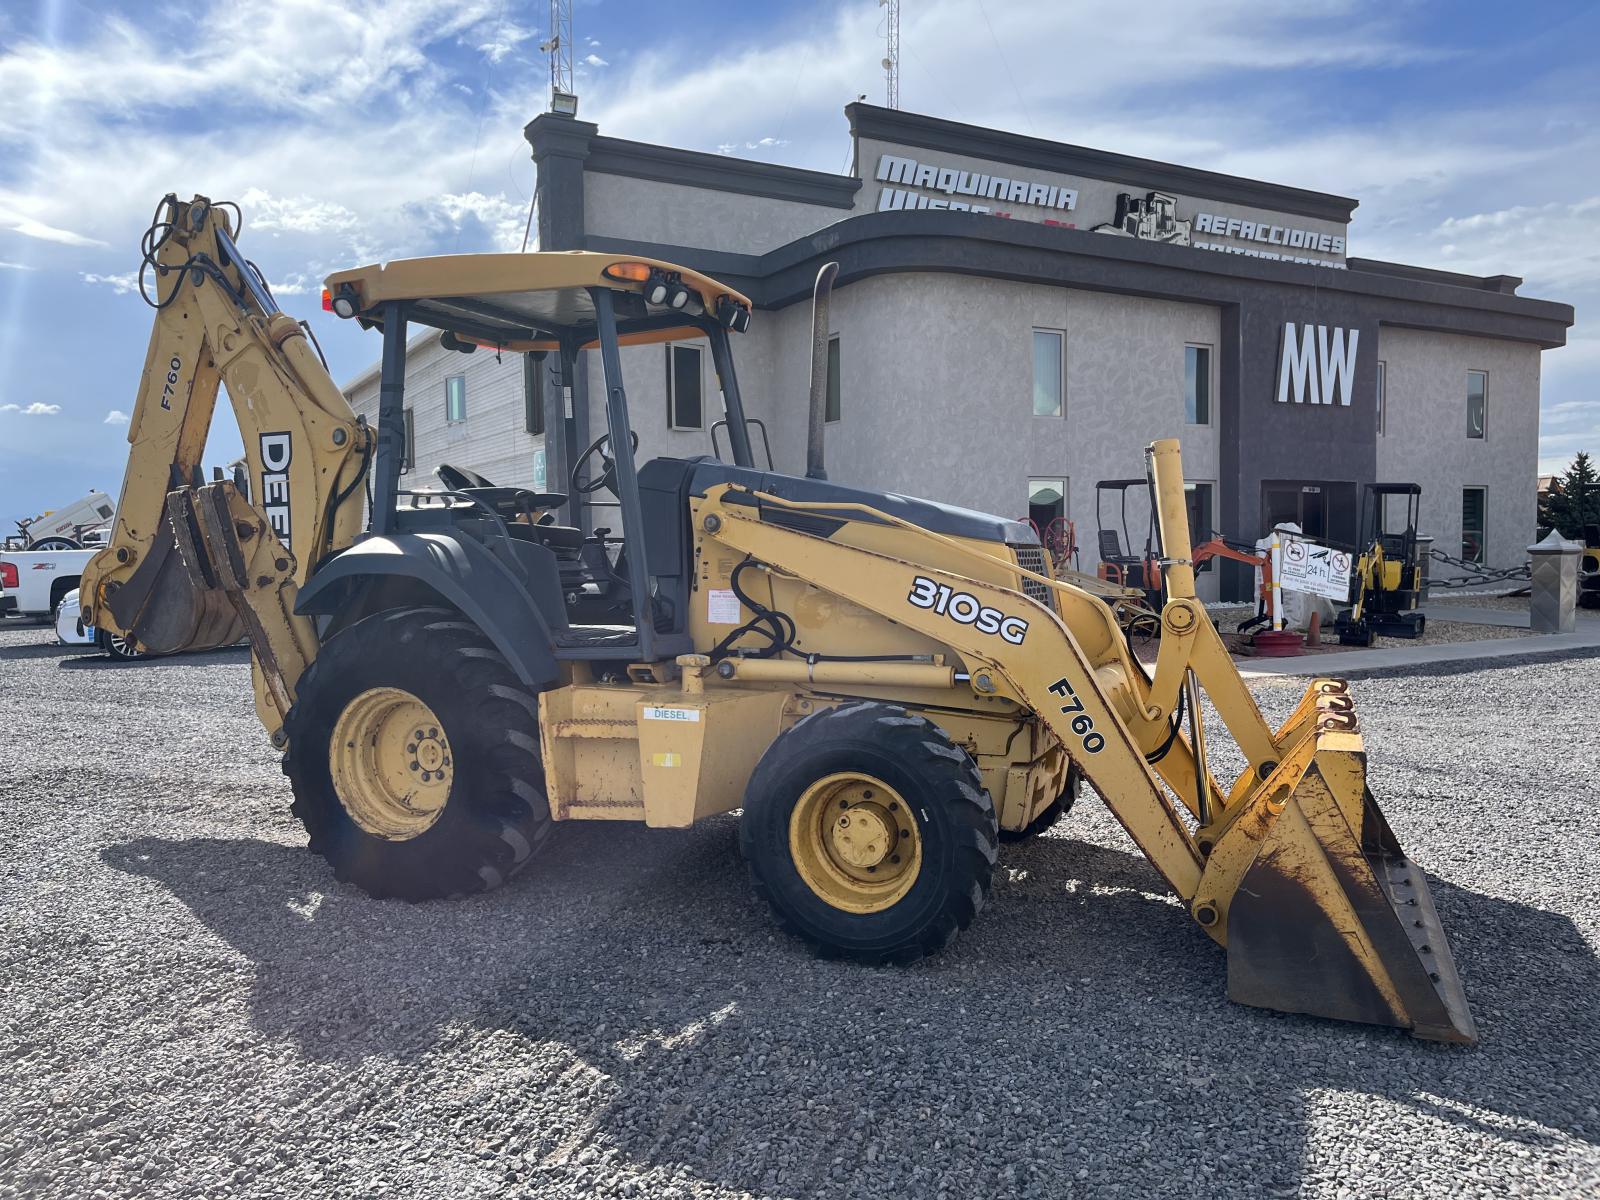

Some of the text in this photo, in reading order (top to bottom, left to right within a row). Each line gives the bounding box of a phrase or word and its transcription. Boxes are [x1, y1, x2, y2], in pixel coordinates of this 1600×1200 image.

[877, 154, 1079, 210] MAQUINARIA
[1196, 213, 1345, 254] REFACCIONES
[160, 357, 182, 411] F760
[1277, 322, 1360, 406] MW
[1307, 564, 1318, 576] 24
[907, 576, 1029, 645] 310SG
[653, 709, 688, 720] DIESEL
[1047, 677, 1105, 754] F760
